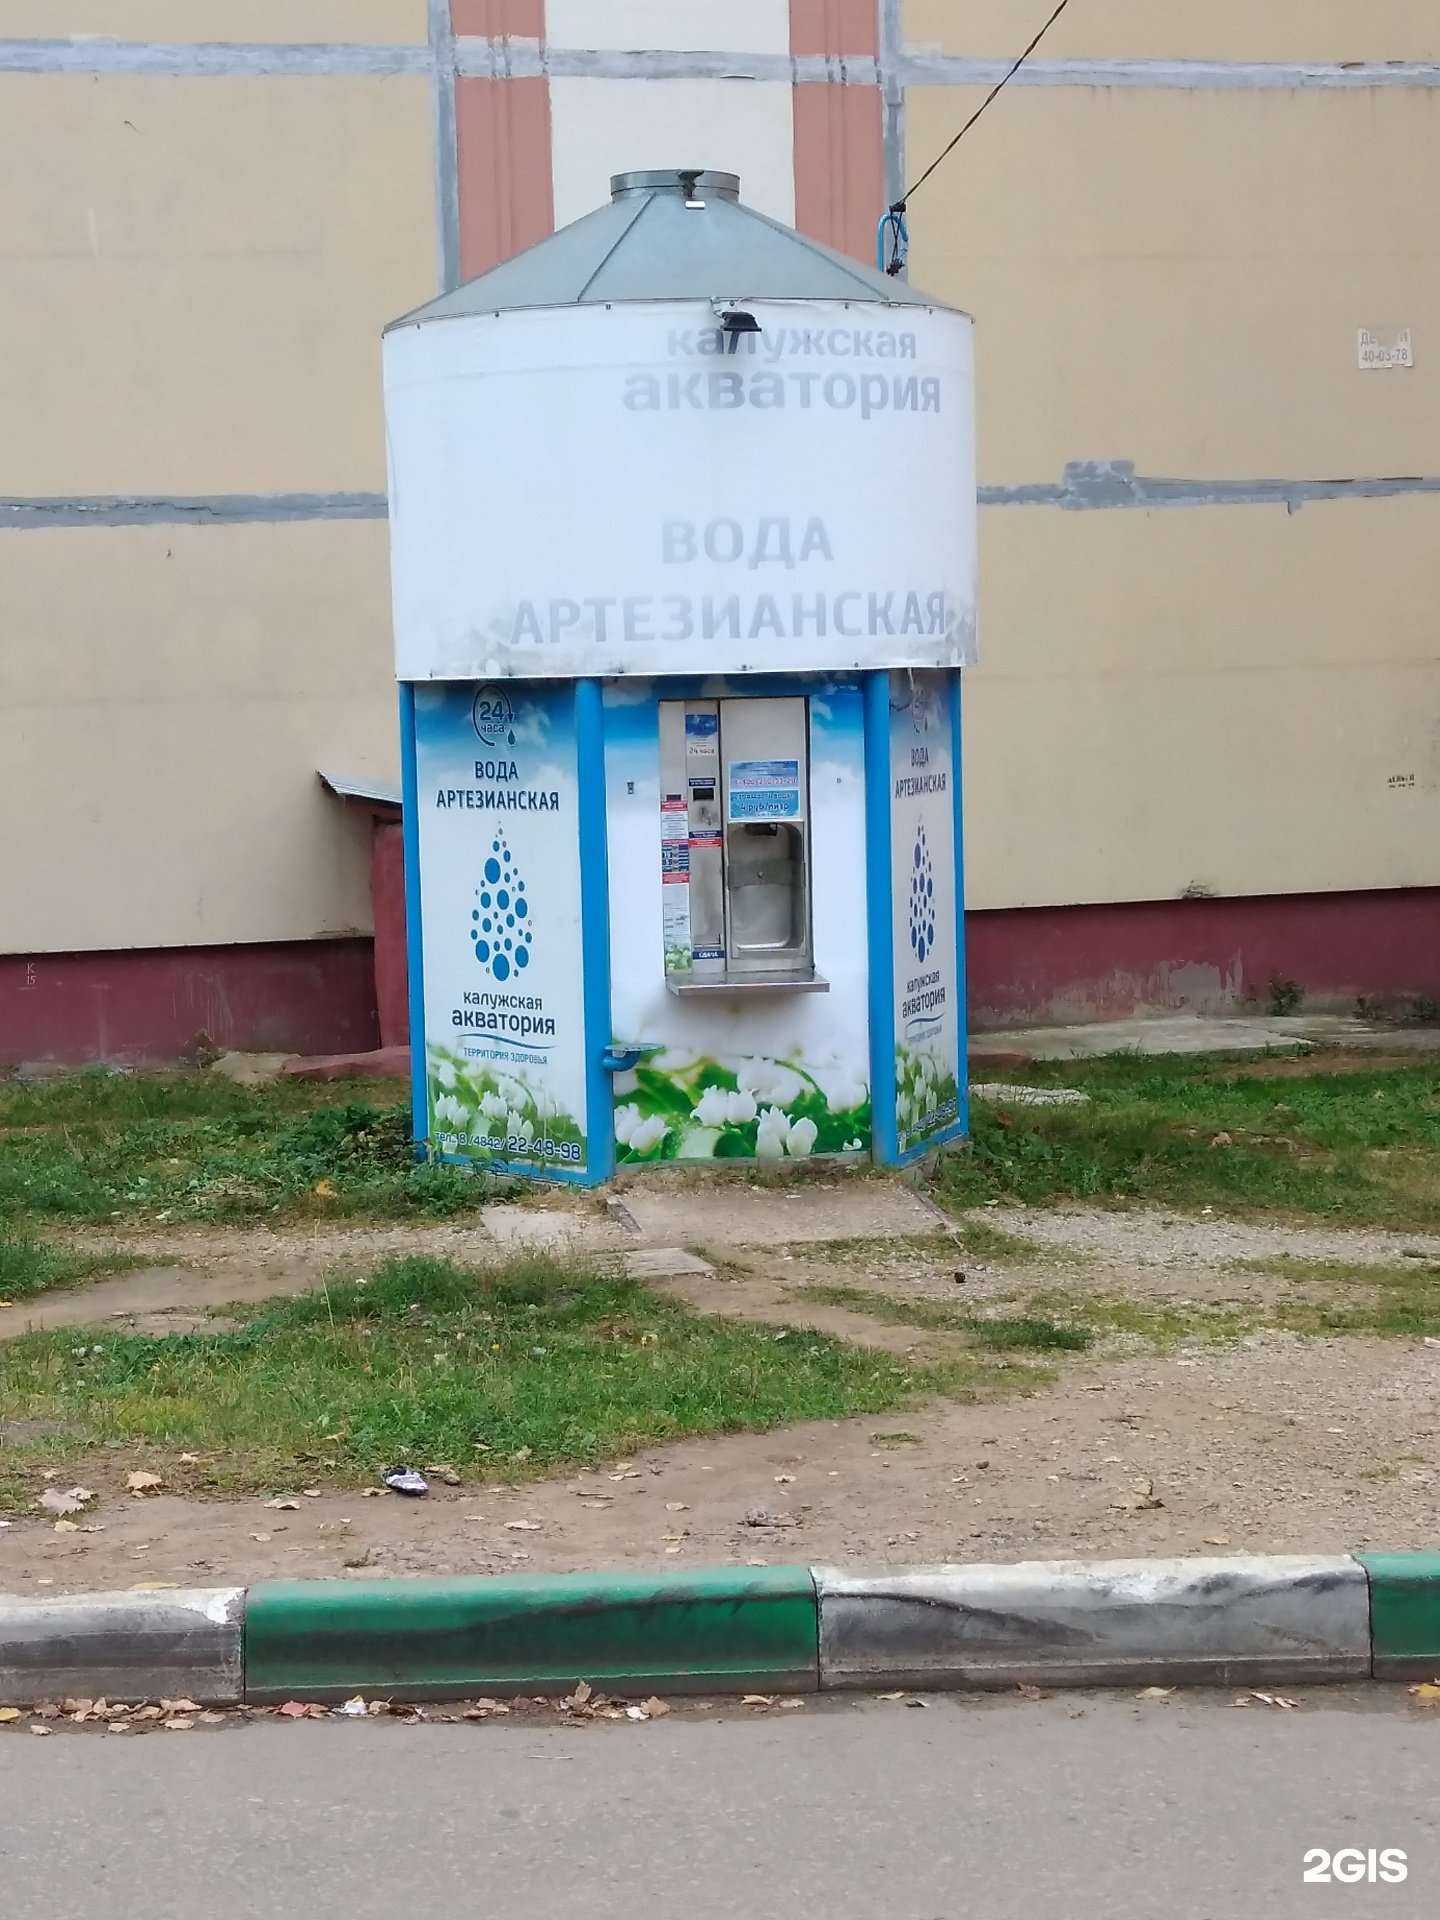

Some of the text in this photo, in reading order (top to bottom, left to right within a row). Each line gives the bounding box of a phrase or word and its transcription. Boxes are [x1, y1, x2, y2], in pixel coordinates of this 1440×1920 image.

[666, 327, 917, 362] калужская
[622, 370, 941, 420] акватория
[661, 516, 834, 570] ВОДА
[510, 590, 946, 644] АРТЕЗИАНСКАЯ
[479, 701, 504, 721] 24
[481, 724, 505, 733] часа
[911, 747, 929, 768] ВОДА
[474, 760, 519, 782] ВОДА
[895, 772, 947, 799] АРТЕЗИАНСКАЯ
[436, 790, 560, 811] АРТЕЗИАНСКАЯ
[463, 991, 543, 1010] калужская
[902, 986, 946, 1018] акватория
[451, 1009, 556, 1037] акватория
[464, 1047, 548, 1065] ТЕРРИТОРИЯ ЗДОРОВЬЯ
